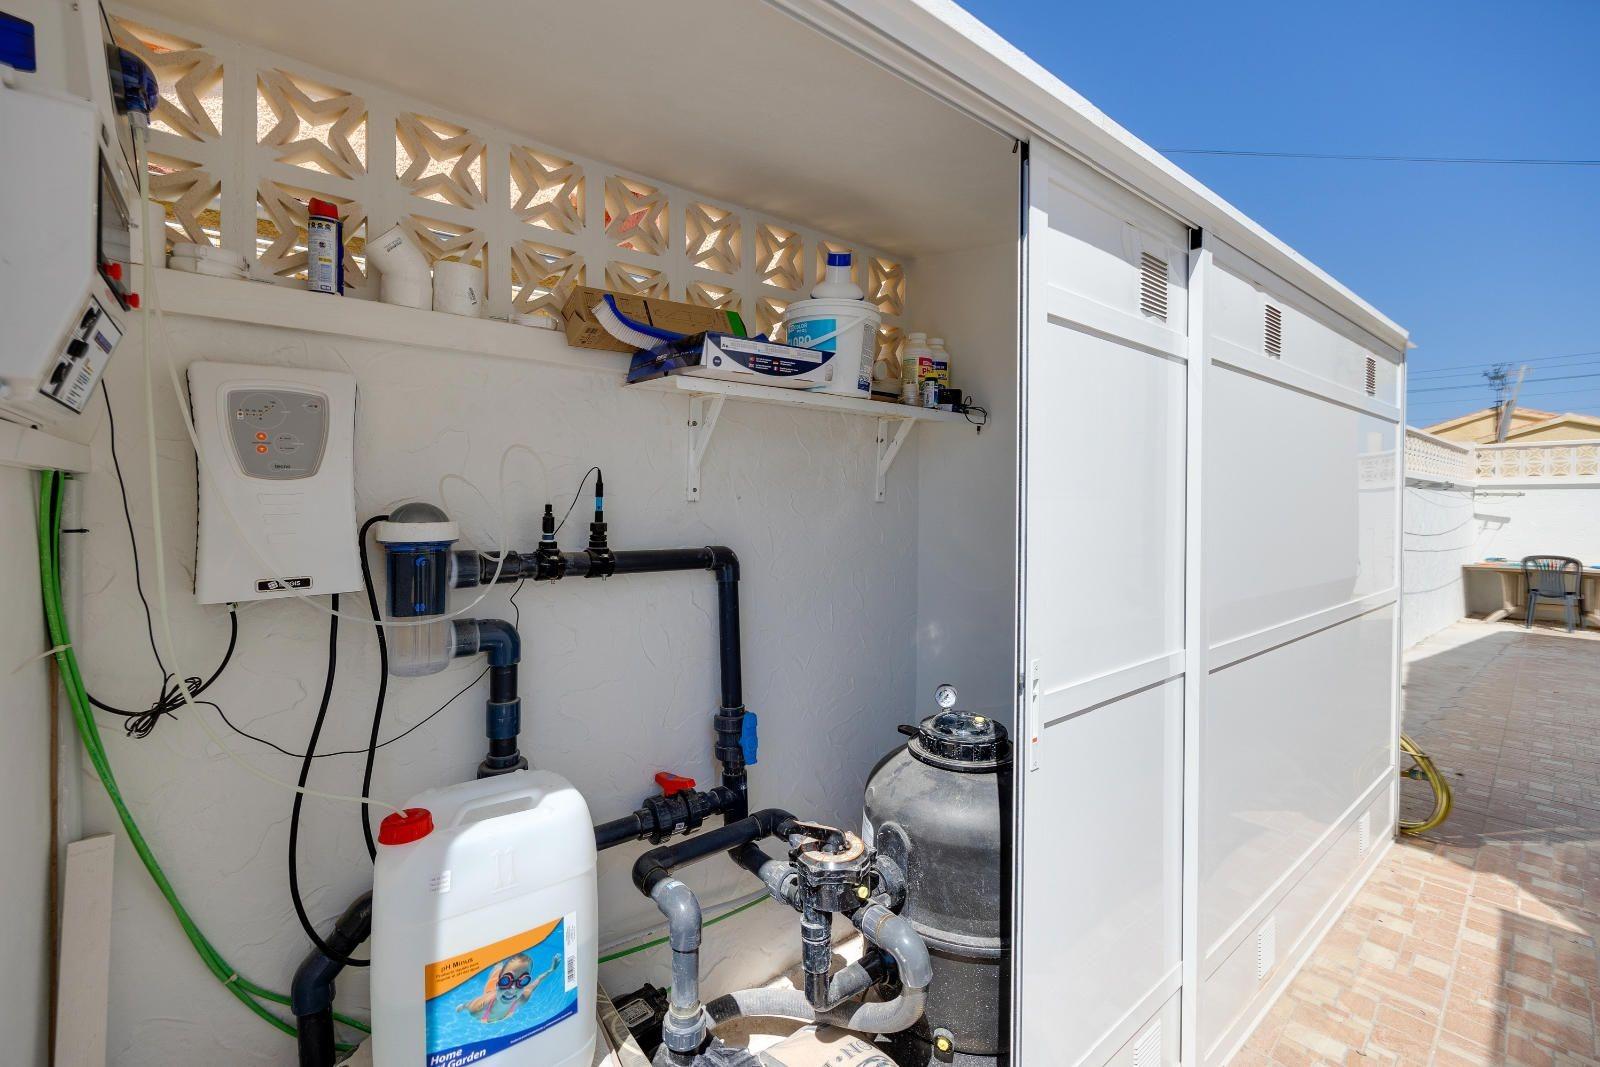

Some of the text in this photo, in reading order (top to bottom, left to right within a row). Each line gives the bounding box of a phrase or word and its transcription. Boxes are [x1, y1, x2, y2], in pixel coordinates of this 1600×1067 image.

[452, 957, 474, 969] Minus
[430, 1049, 463, 1066] Home
[447, 1049, 487, 1067] Garden
